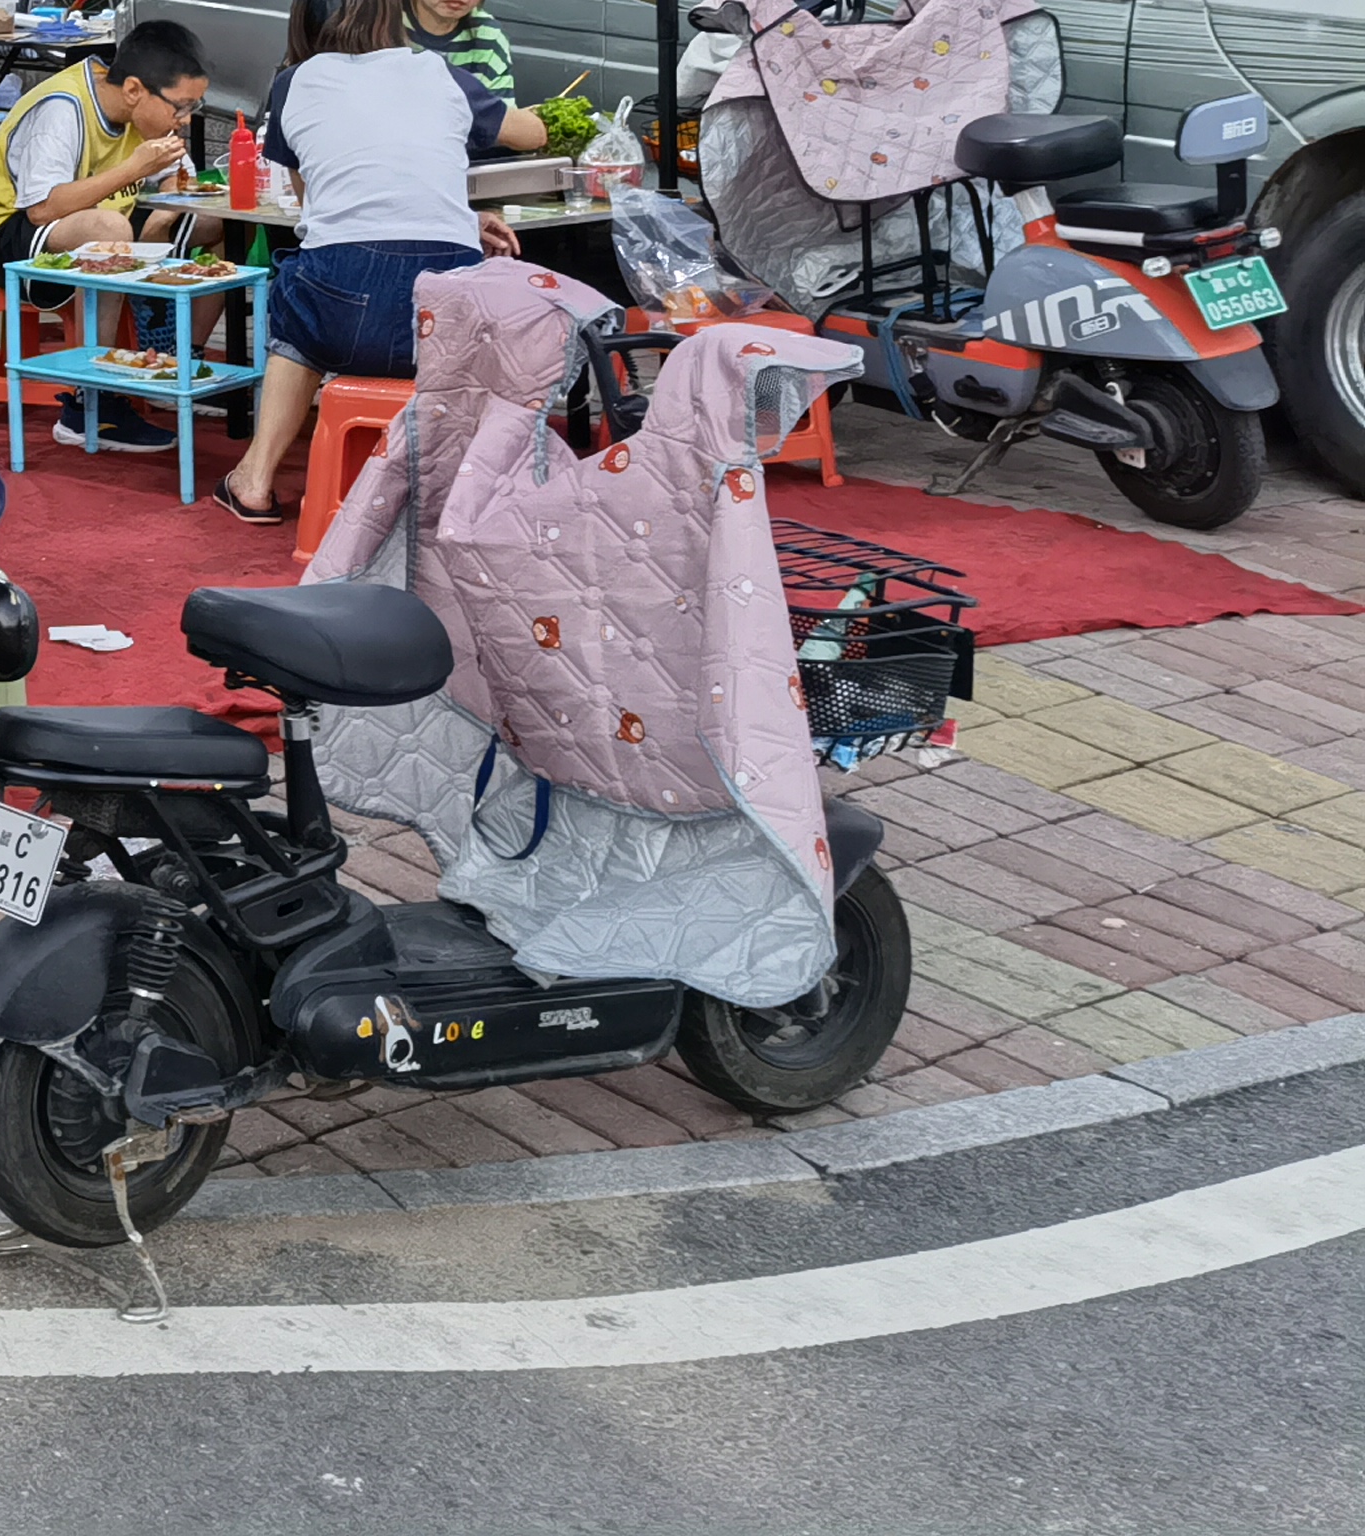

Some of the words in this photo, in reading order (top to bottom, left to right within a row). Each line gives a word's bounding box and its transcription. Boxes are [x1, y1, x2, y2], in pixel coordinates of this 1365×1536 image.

[1222, 117, 1257, 140] 新日
[1206, 288, 1278, 321] 055663
[433, 1020, 485, 1044] LOE
